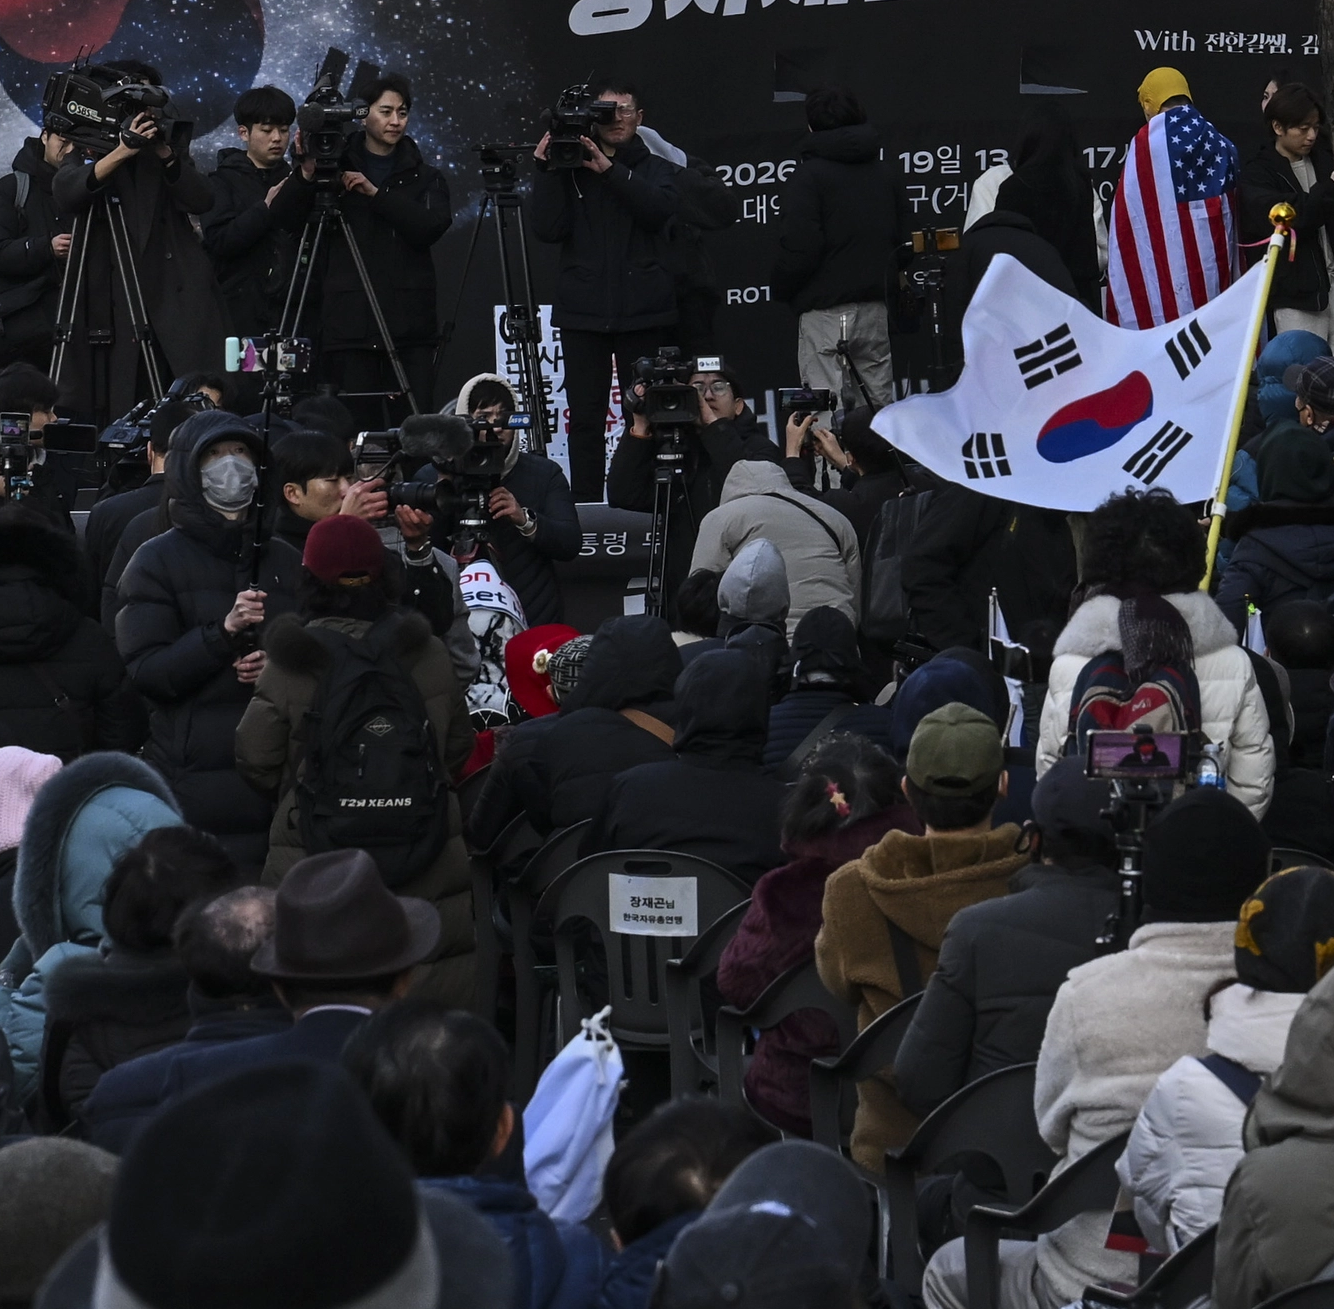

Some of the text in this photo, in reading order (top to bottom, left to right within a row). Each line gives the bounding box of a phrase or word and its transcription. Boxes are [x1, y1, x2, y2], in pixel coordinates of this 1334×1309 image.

[1134, 30, 1196, 52] With
[1204, 31, 1293, 55] 전한길쌤,
[77, 104, 91, 118] SBS
[716, 159, 797, 188] 2026
[898, 144, 962, 175] 19일
[367, 797, 413, 808] XEANS
